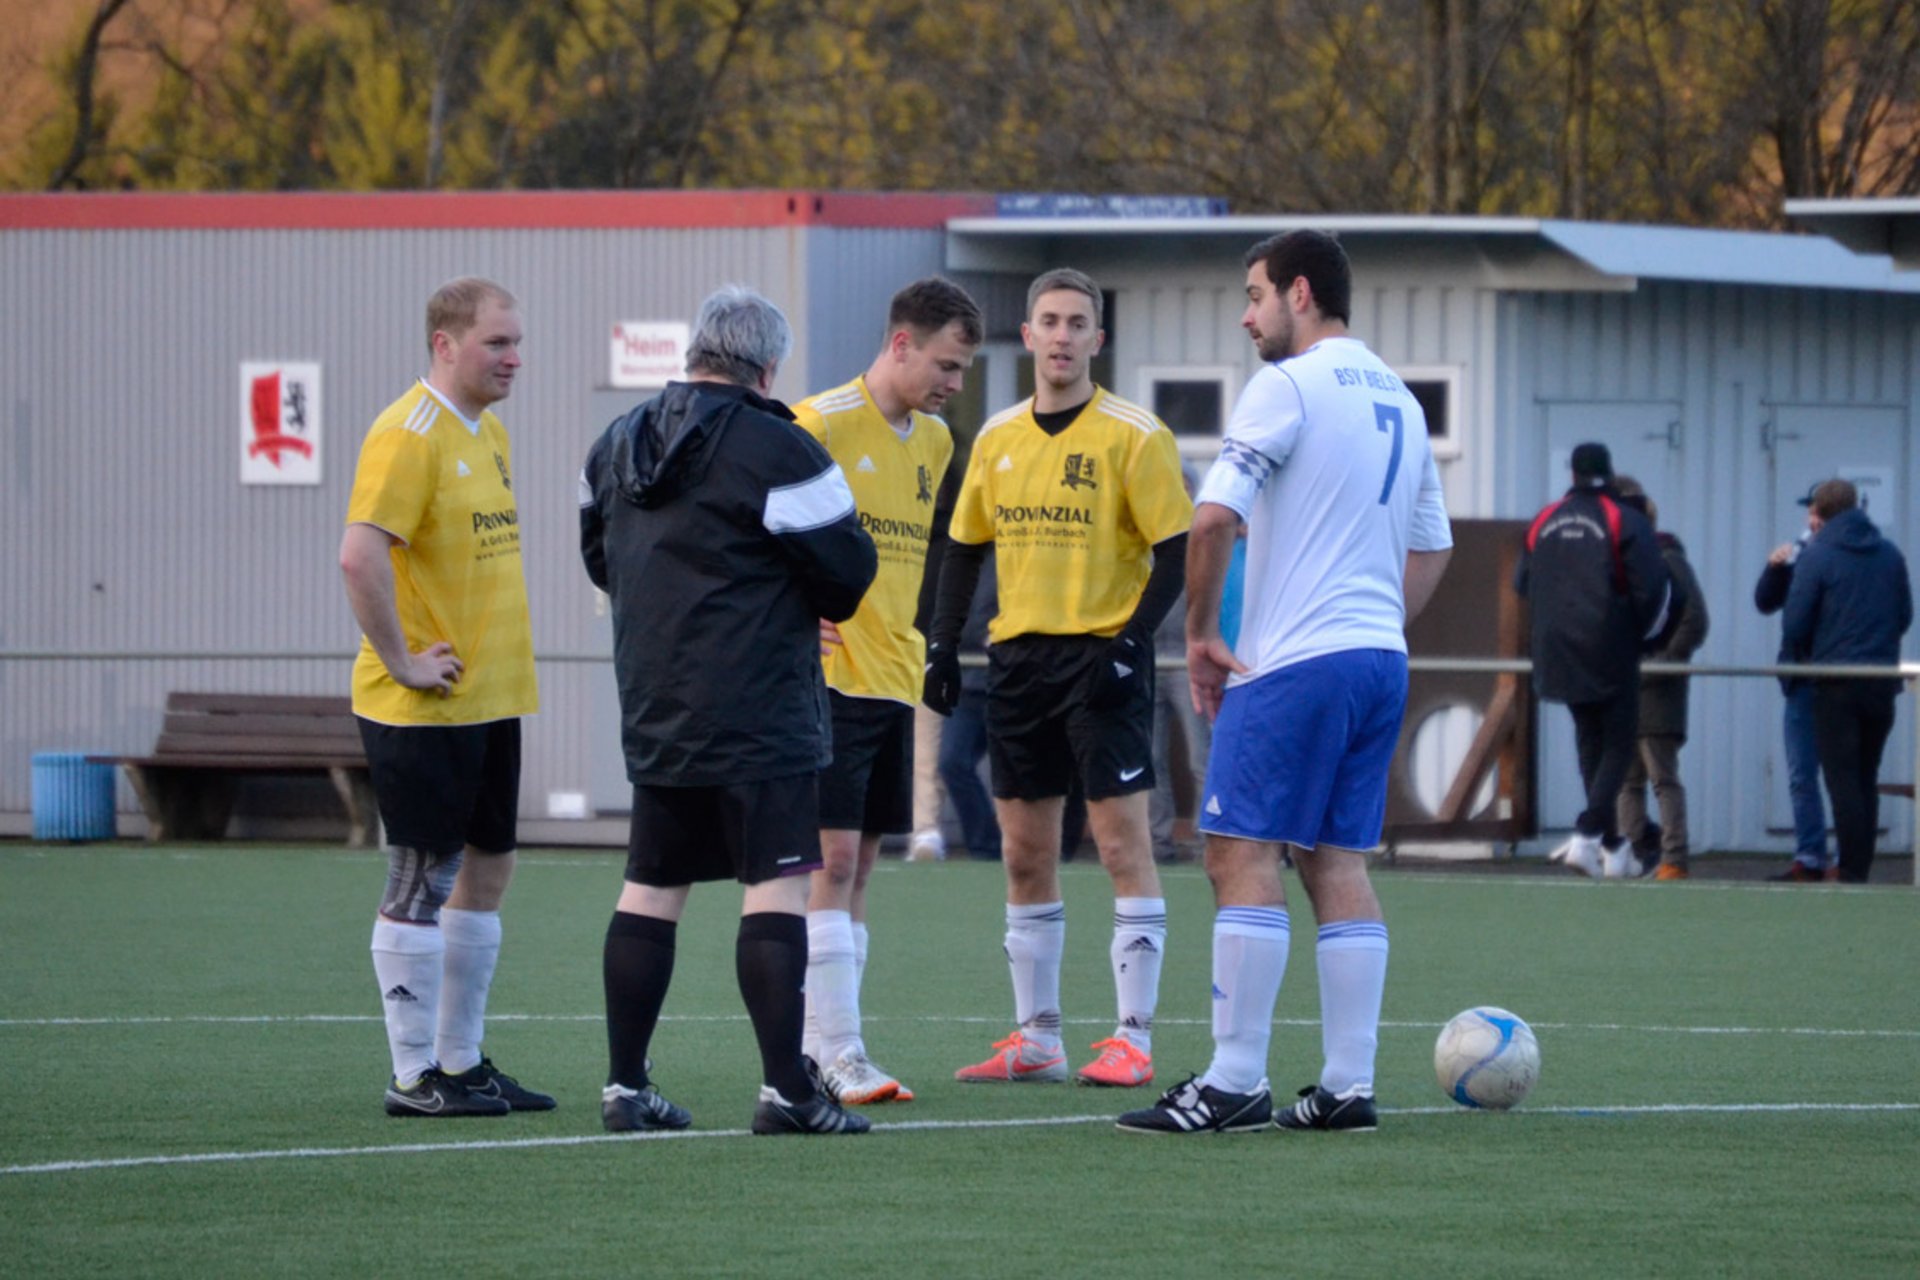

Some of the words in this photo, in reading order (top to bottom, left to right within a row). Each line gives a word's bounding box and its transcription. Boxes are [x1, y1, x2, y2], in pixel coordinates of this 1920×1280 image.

[623, 332, 676, 357] Heim
[1372, 401, 1404, 505] 7
[994, 504, 1093, 525] PROVINZIAL
